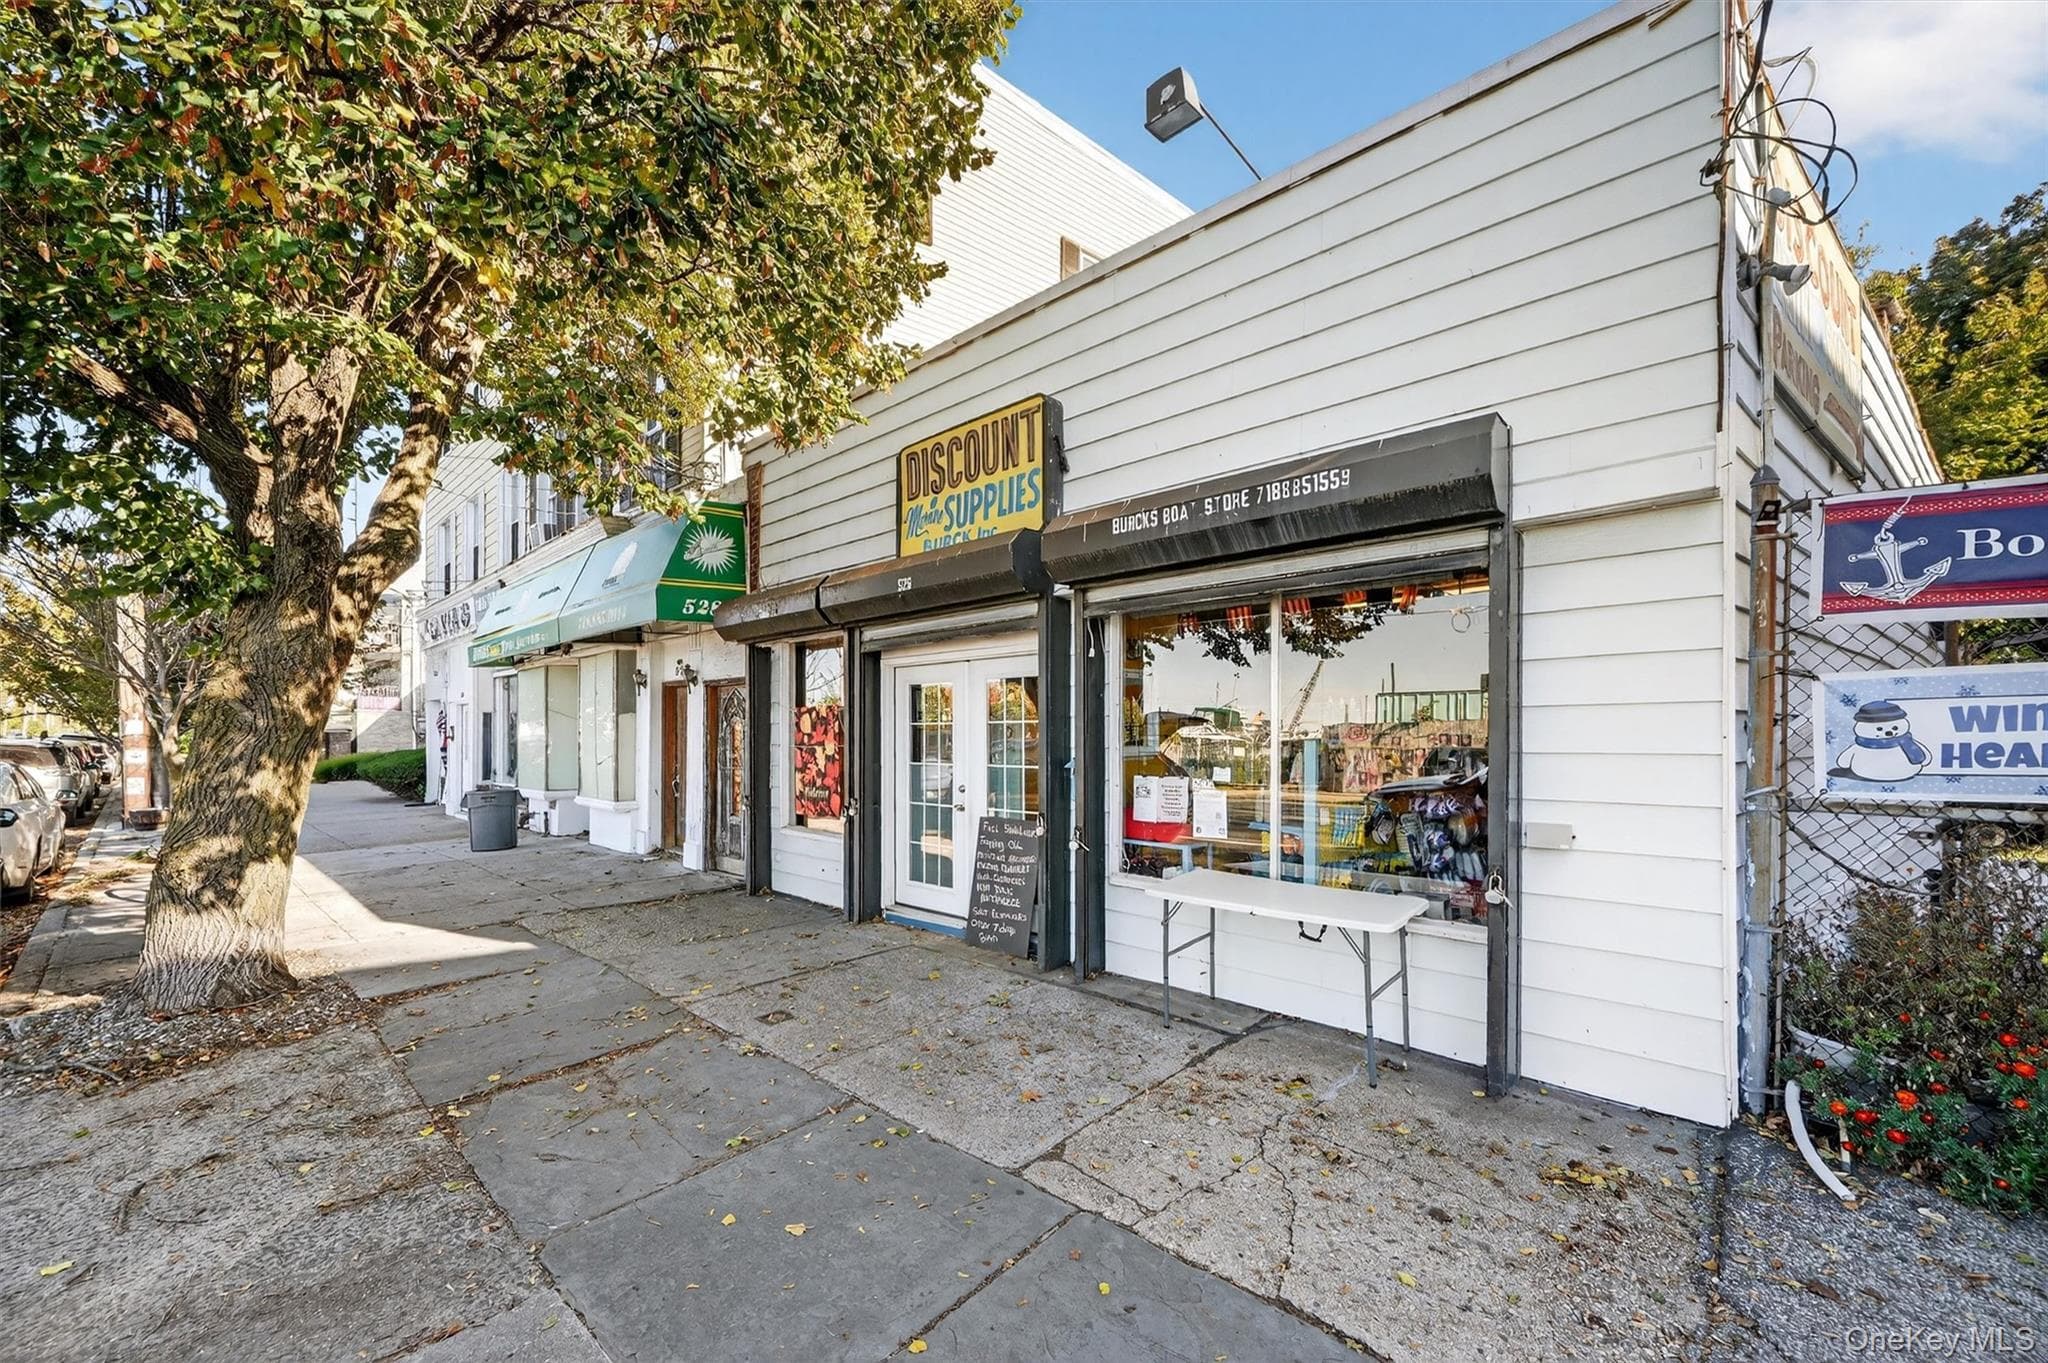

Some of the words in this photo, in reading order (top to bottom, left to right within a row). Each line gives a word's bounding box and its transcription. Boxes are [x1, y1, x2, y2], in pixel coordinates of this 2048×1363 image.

[906, 406, 1041, 502] DISCOUNT
[944, 467, 1041, 532] SUPPLIES
[1204, 489, 1250, 516] STORE
[1256, 468, 1350, 504] 7188851559
[1956, 527, 2046, 561] Bo
